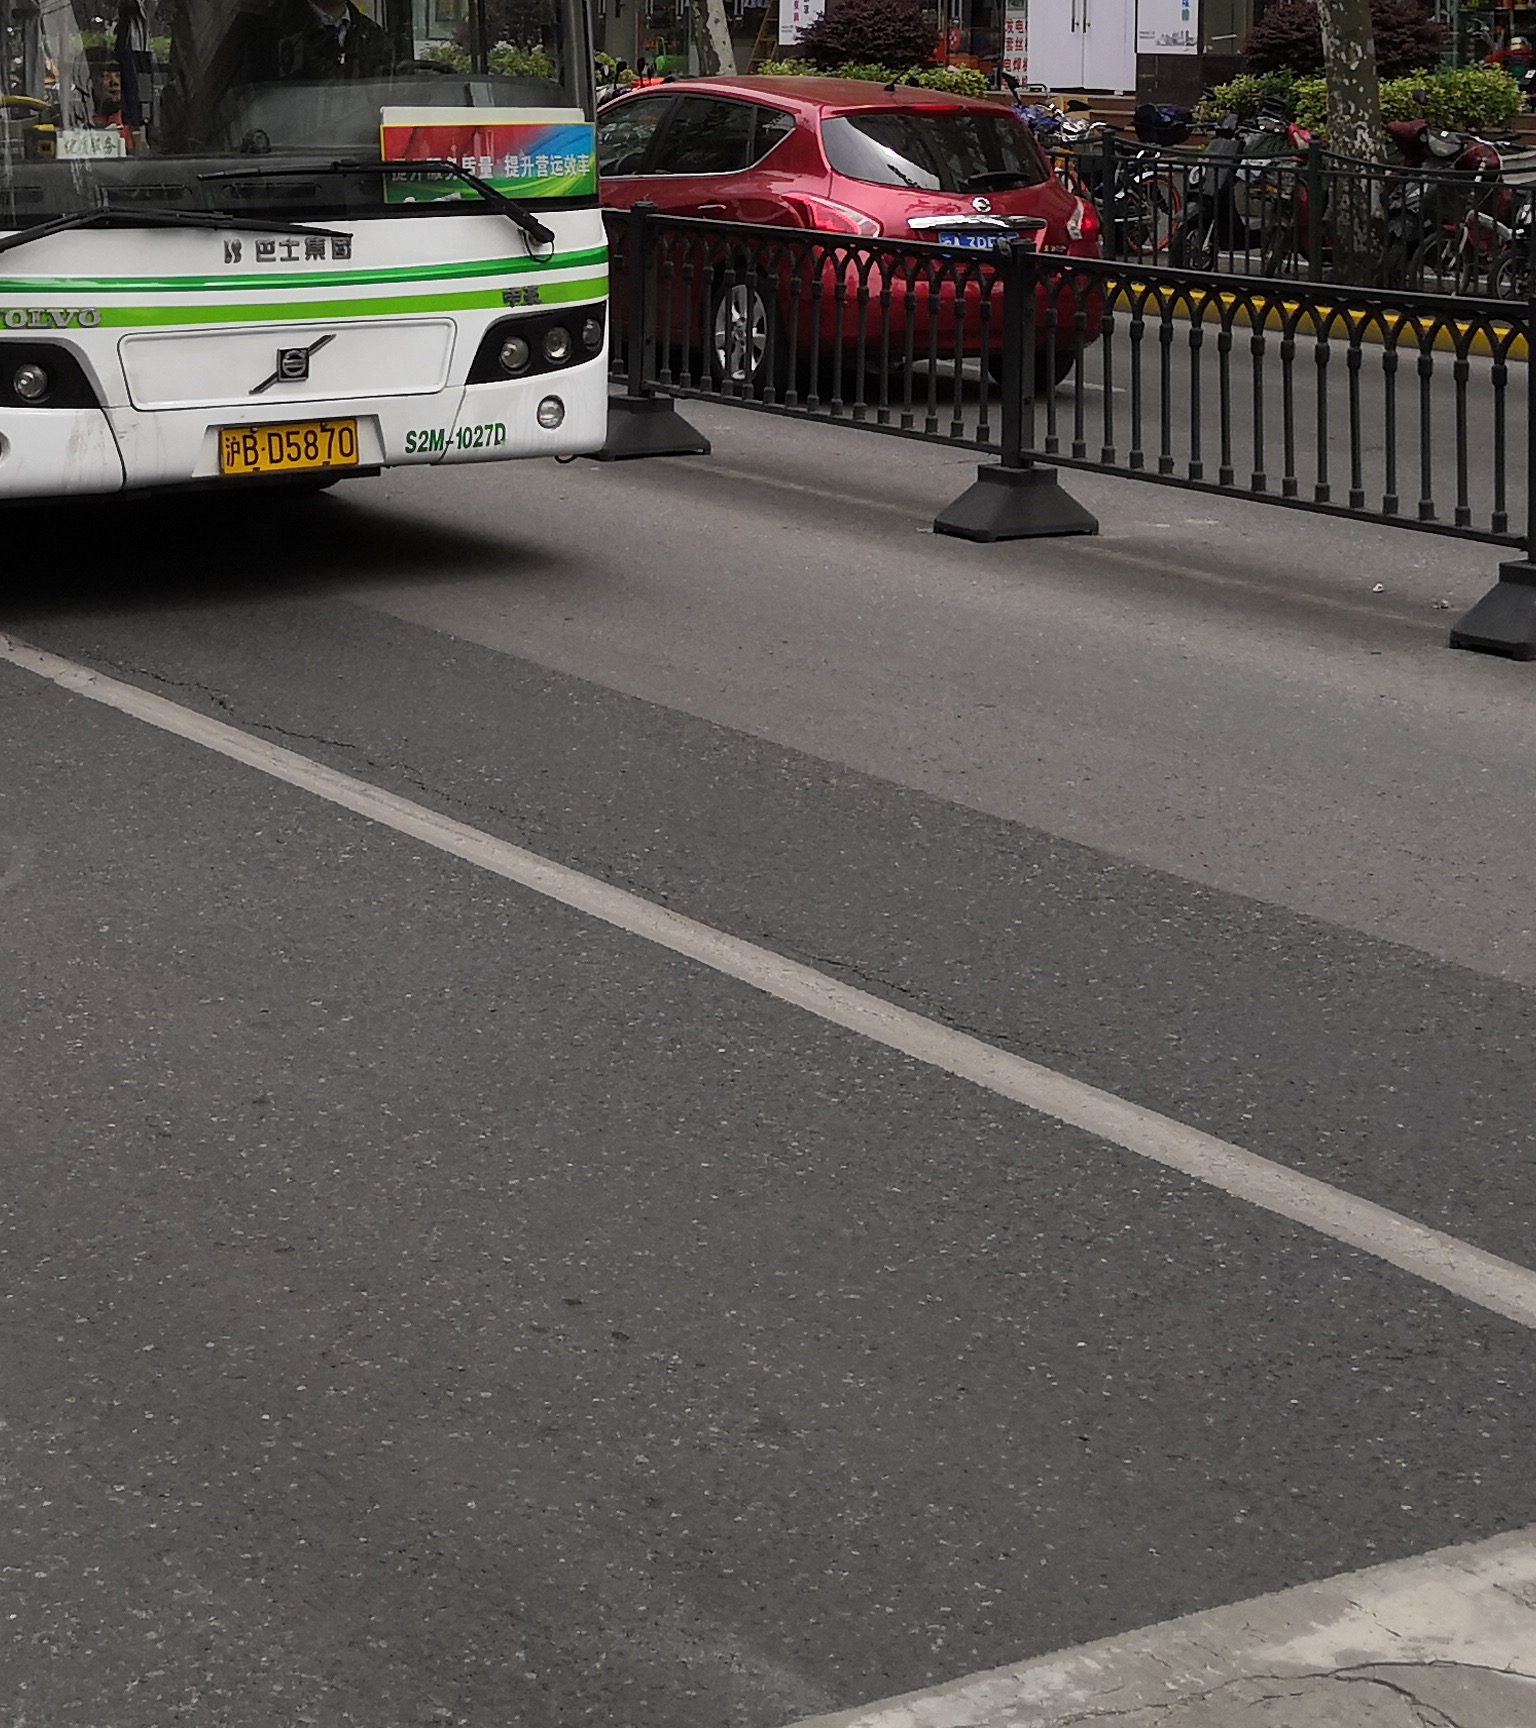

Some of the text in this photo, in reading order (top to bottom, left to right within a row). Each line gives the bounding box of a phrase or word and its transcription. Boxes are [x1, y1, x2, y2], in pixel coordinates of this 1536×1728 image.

[503, 153, 592, 179] 提升营运效率
[254, 237, 353, 263] 巴士集团
[404, 423, 507, 454] S2M-1027D
